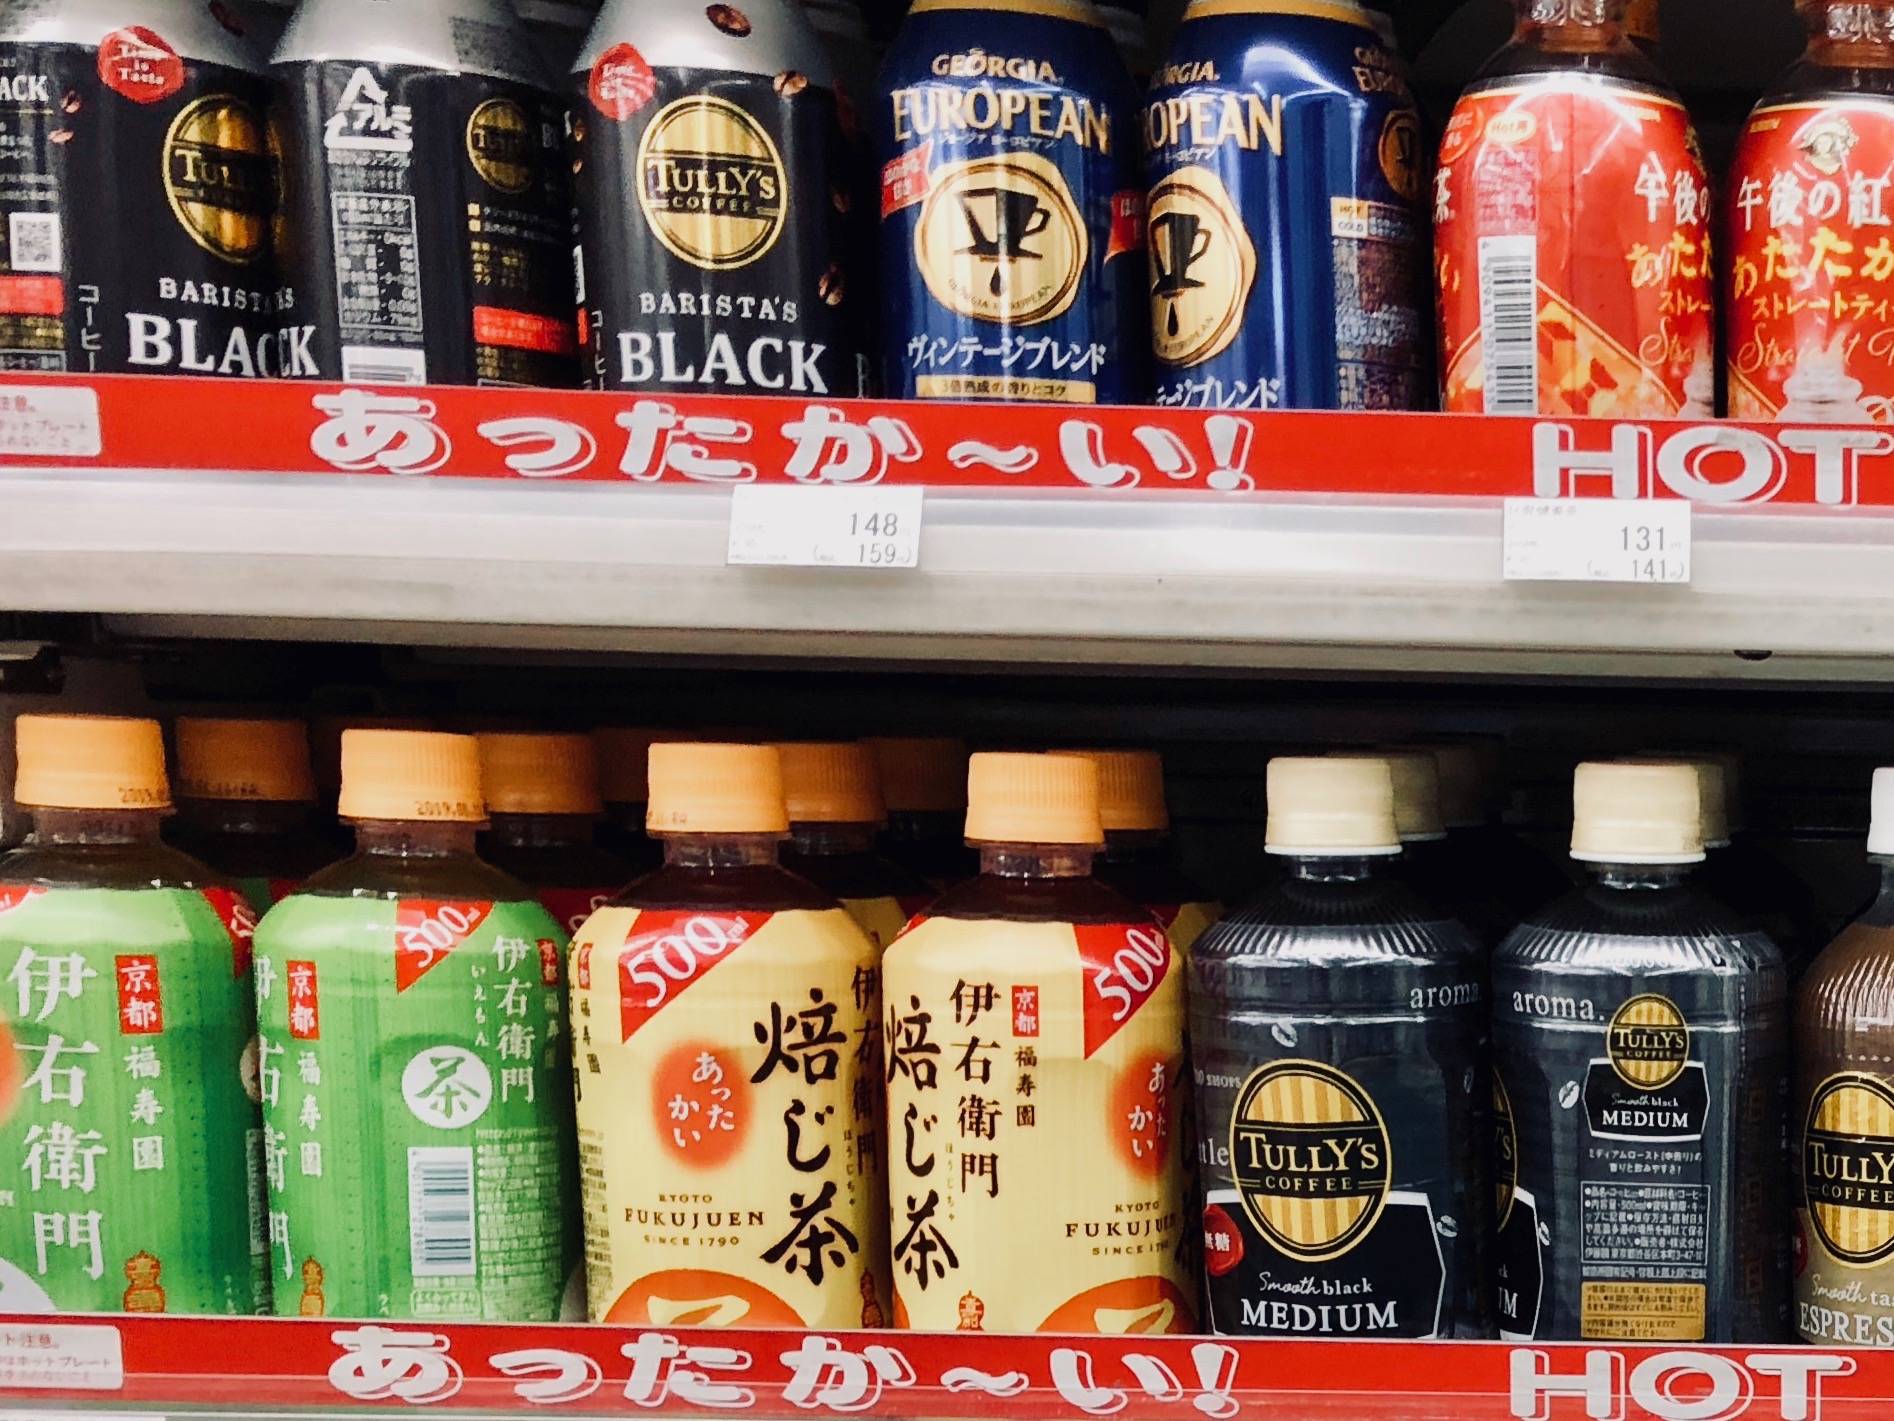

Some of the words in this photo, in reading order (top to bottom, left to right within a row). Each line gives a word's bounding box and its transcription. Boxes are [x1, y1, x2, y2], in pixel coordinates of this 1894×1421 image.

[890, 86, 1110, 154] EUROPEAN
[647, 160, 776, 200] TULLY'S
[639, 292, 799, 323] BARISTA'S
[616, 331, 829, 394] BLACK
[907, 333, 1107, 375] ヴィンテージブレンド
[1532, 422, 1894, 508] HOT
[122, 961, 159, 1031] 京都
[288, 965, 316, 1034] 京都
[470, 962, 488, 1048] いえもん
[1014, 989, 1037, 1034] 京都
[492, 935, 535, 1104] 伊右衛門
[1613, 1028, 1684, 1049] TULLY'S
[123, 1044, 165, 1171] 福寿園
[415, 1055, 482, 1120] 茶
[949, 979, 1002, 1199] 伊右衛門
[1014, 1045, 1038, 1128] 福寿園
[8, 944, 107, 1281] 伊右衛門
[298, 1050, 323, 1178] 福寿園
[1602, 1109, 1689, 1128] MEDIUM
[750, 987, 859, 1287] 焙じ茶
[885, 995, 960, 1292] 焙じ茶
[1239, 1131, 1379, 1172] TULLY'S
[659, 1194, 713, 1205] KYOTO
[1265, 1175, 1353, 1192] COFFEE
[1820, 1183, 1894, 1205] COFFEE
[625, 1209, 765, 1228] FUKUJUEN
[1115, 1200, 1160, 1213] KYOTO
[644, 1236, 692, 1247] SINCE
[699, 1236, 740, 1247] 1790
[1258, 1271, 1321, 1297] Smooth
[1322, 1277, 1373, 1296] black
[1811, 1272, 1869, 1303] Smooth
[1240, 1298, 1398, 1332] MEDIUM
